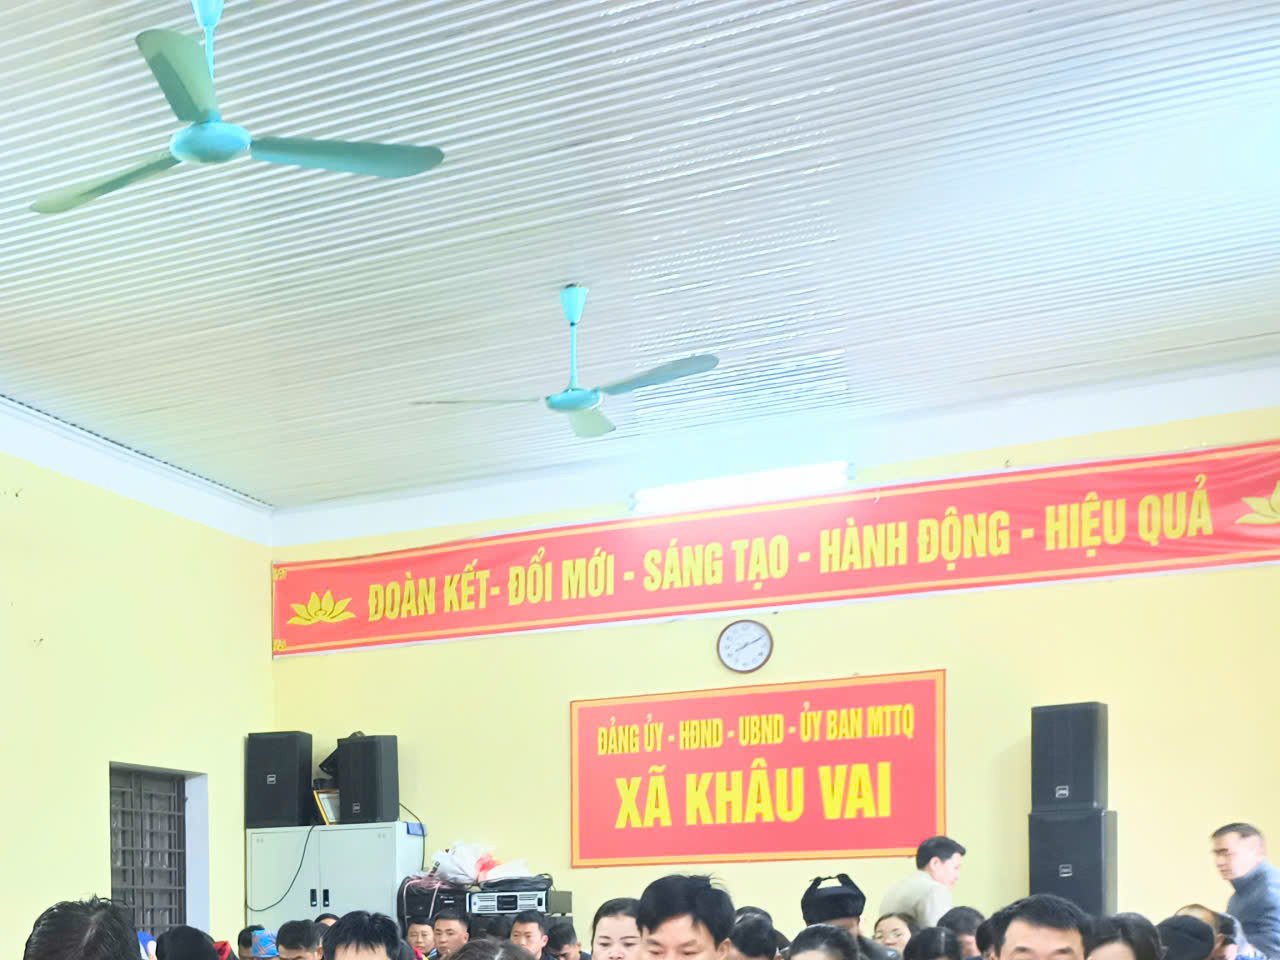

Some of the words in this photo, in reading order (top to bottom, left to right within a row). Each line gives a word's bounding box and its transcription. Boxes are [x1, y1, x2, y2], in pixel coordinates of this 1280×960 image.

[368, 570, 437, 622] ĐOÀN
[507, 547, 552, 606] ĐỔI
[561, 546, 615, 600] MỚI
[644, 538, 724, 592] SÁNG
[731, 533, 789, 591] TẠO
[819, 517, 908, 574] HÀNH
[917, 506, 1010, 571] ĐỘNG
[1045, 491, 1126, 557] HIỆU
[1137, 474, 1214, 547] QUẢ
[597, 717, 640, 756] ĐẢNG
[643, 713, 664, 753] ỦY
[679, 717, 724, 750] HĐND
[738, 714, 785, 747] UBND
[800, 701, 822, 742] ỦY
[826, 707, 863, 741] BAN
[866, 703, 915, 740] MTTQ
[614, 763, 672, 829] XÃ
[685, 757, 805, 826] KHÂU
[818, 761, 892, 820] VAI
